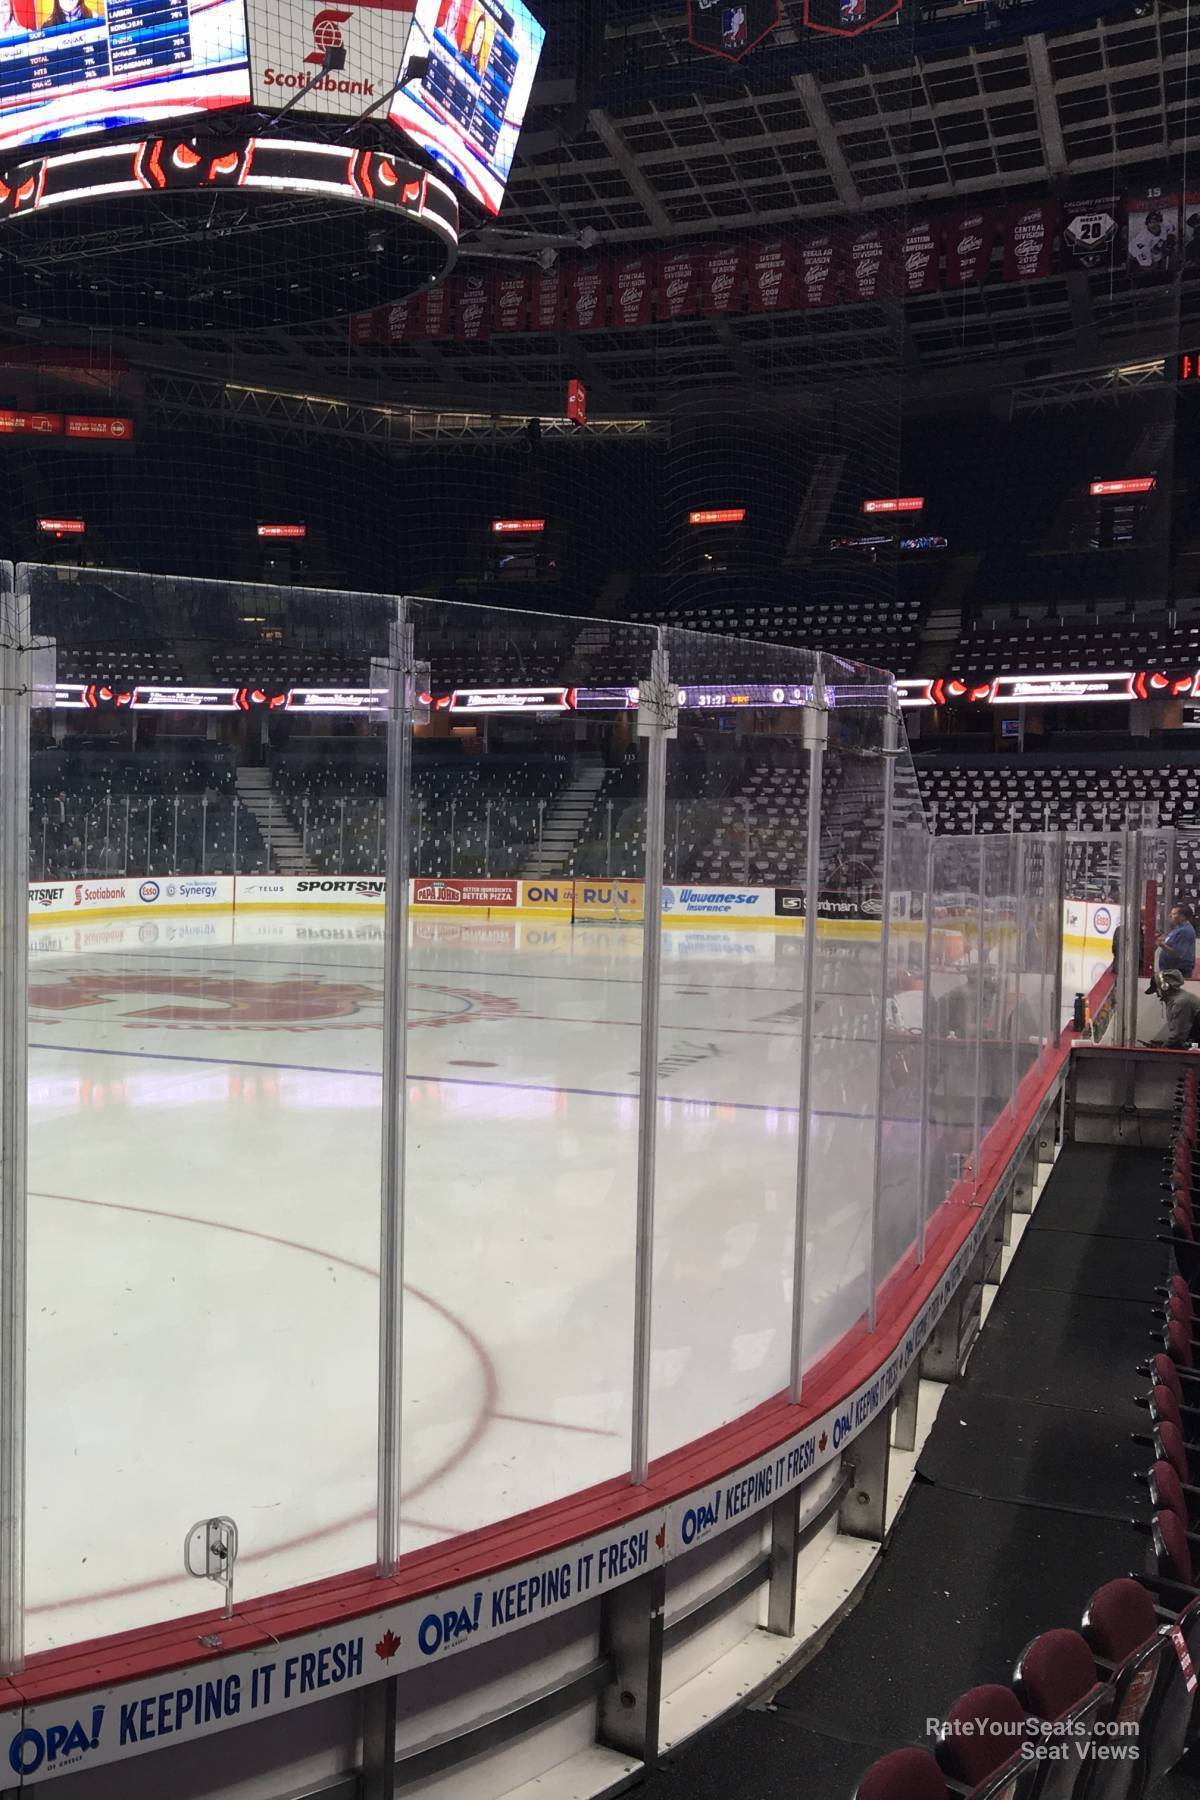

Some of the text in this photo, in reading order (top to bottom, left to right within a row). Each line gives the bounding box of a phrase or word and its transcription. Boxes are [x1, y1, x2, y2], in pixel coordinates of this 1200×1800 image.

[31, 56, 48, 64] TOTAL
[263, 69, 374, 97] Scotiabank
[1147, 187, 1161, 198] 19
[1014, 224, 1045, 233] CENTRAL
[1081, 223, 1101, 239] 20
[1014, 231, 1045, 240] DIVISION
[853, 242, 883, 251] CENTRAL
[699, 695, 726, 705] 31:21
[28, 887, 64, 900] RTSNET
[84, 887, 126, 900] Scotiabank
[142, 886, 157, 896] Esso
[180, 884, 217, 897] Synergy
[296, 881, 387, 893] SPORTSN
[418, 889, 435, 900] PAPA
[462, 892, 513, 901] BETTER PIZZA.
[527, 887, 558, 902] ON
[679, 889, 758, 904] Wawanesa
[686, 904, 731, 912] Insurance
[833, 1402, 854, 1449] OPA!
[681, 1436, 816, 1545] OPA! KEEPING IT FRESH
[418, 1530, 648, 1656] OPA! KEEPING IT FRESH
[8, 1636, 364, 1776] OPA! KEEPING IT FRESH
[47, 1754, 83, 1772] OF GREECE
